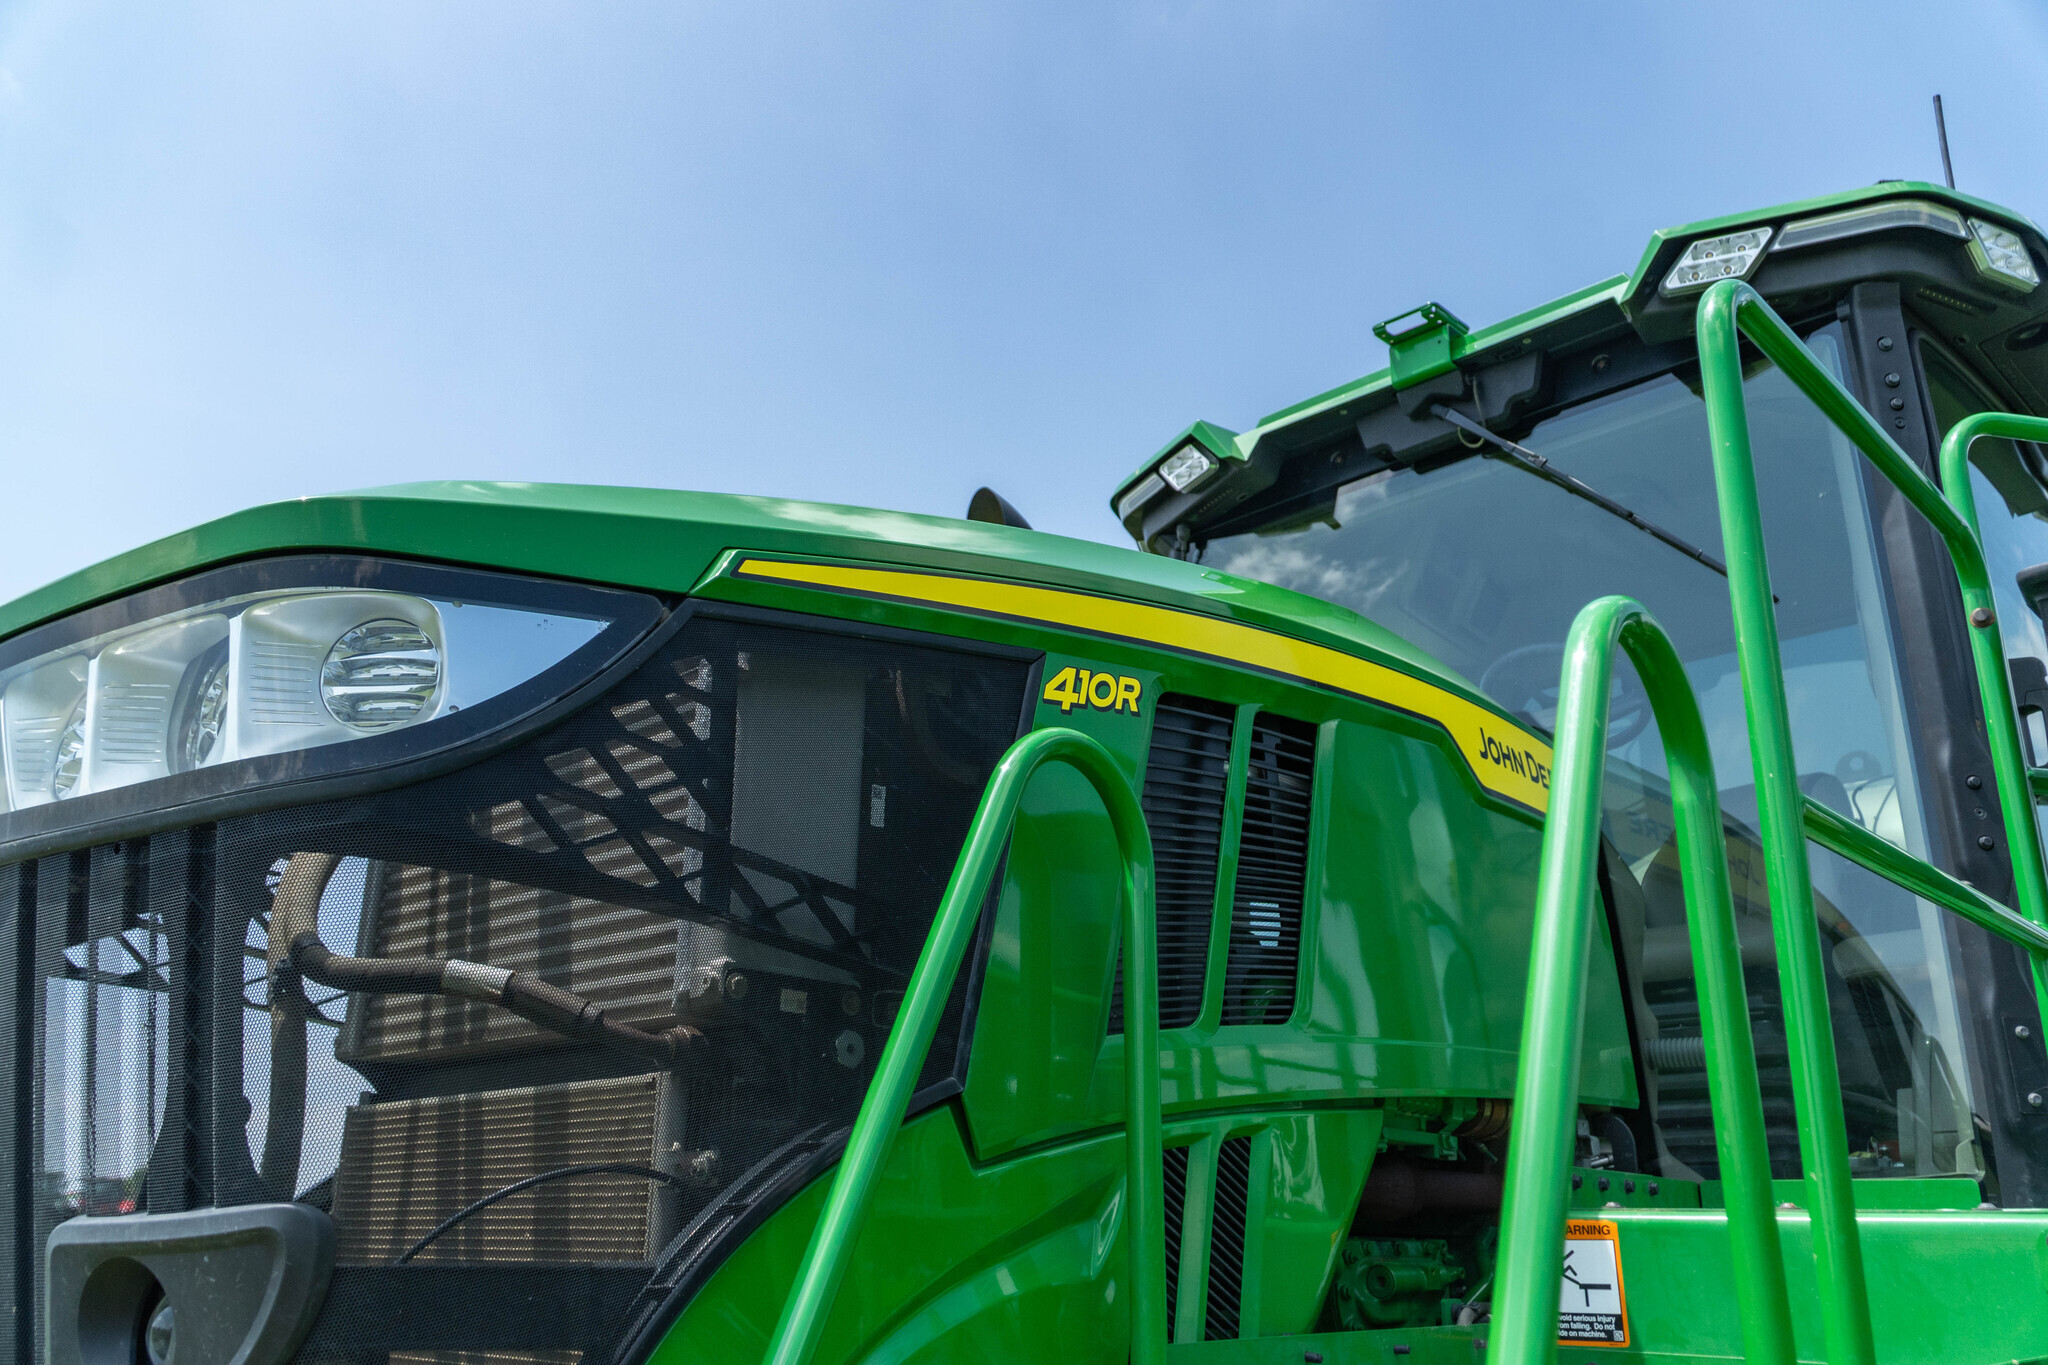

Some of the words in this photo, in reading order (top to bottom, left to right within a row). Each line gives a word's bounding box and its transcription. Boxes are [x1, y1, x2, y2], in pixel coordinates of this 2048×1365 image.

[1042, 666, 1143, 718] 410R
[1479, 726, 1526, 778] JOHN
[1524, 749, 1552, 791] DE
[1566, 1224, 1611, 1236] ARNING
[1558, 1313, 1572, 1321] void
[1572, 1314, 1597, 1322] serious
[1597, 1314, 1616, 1324] injury
[1593, 1322, 1604, 1330] Do
[1604, 1323, 1616, 1331] not
[1558, 1329, 1568, 1337] ide
[1578, 1330, 1608, 1338] machine.
